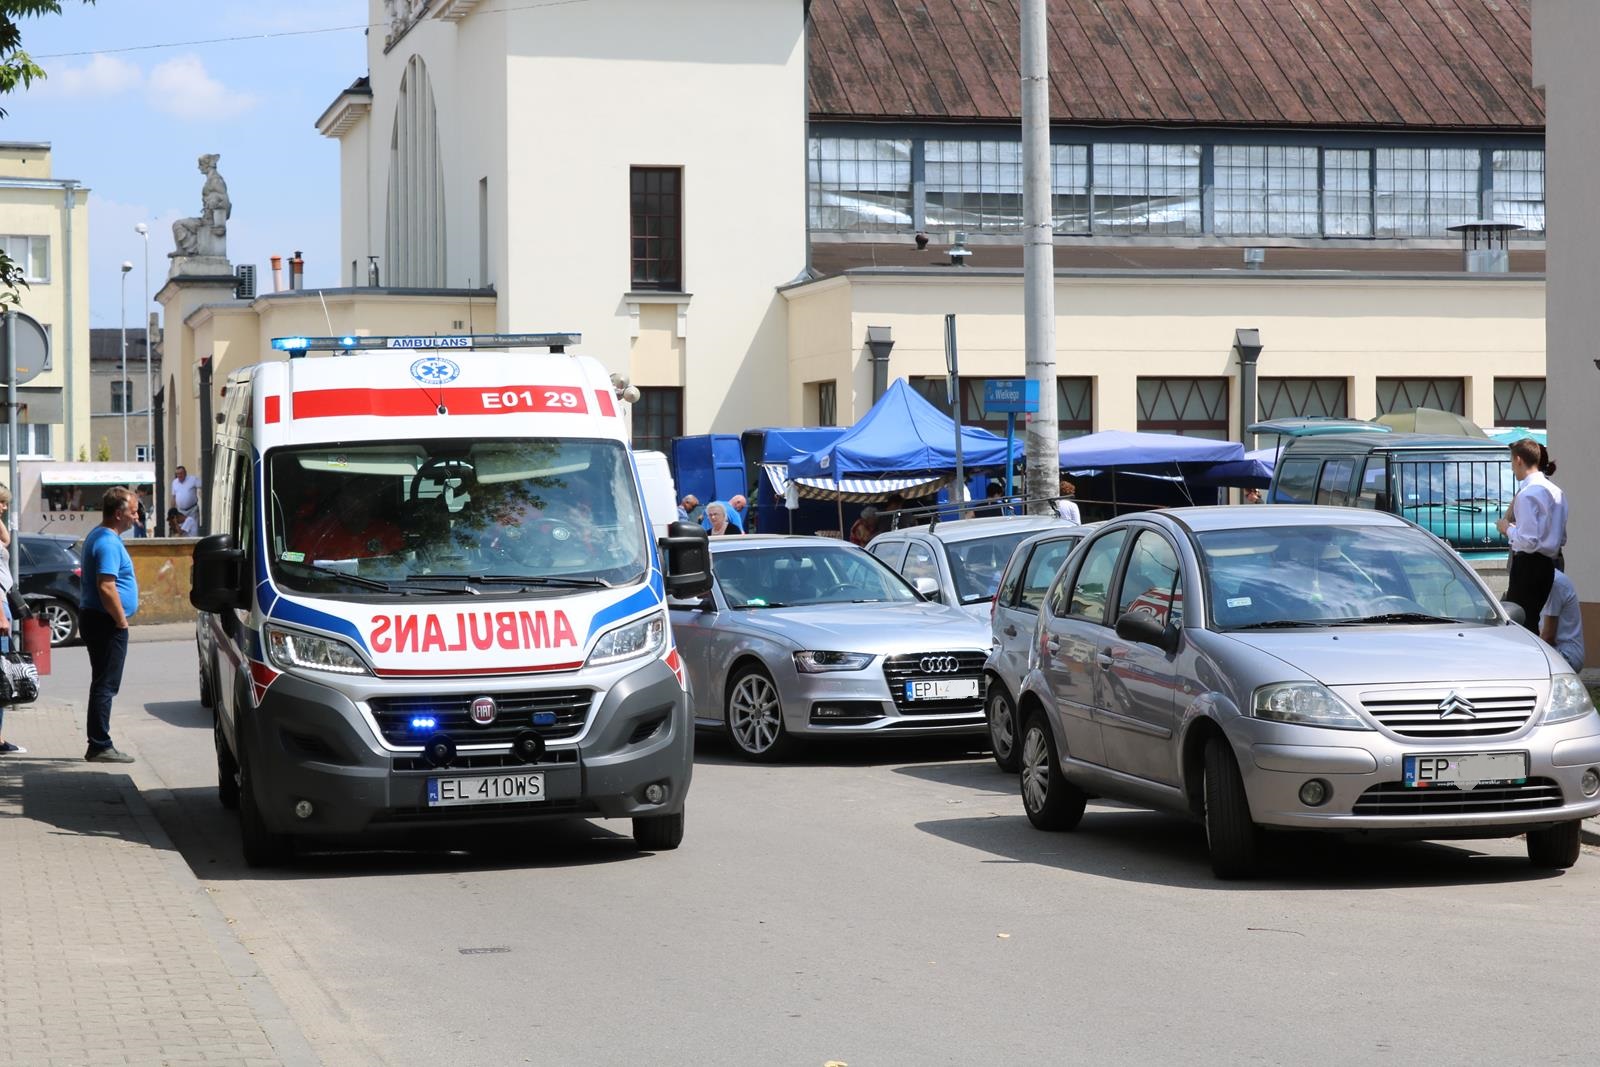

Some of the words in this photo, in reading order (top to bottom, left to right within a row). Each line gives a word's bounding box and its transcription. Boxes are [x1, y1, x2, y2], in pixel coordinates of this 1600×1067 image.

[392, 338, 468, 348] AMBULANS
[481, 391, 534, 409] E01
[543, 391, 578, 408] 29
[476, 705, 493, 718] FIAT
[1419, 758, 1450, 780] EP
[441, 780, 470, 800] EL
[478, 776, 540, 798] 410WS
